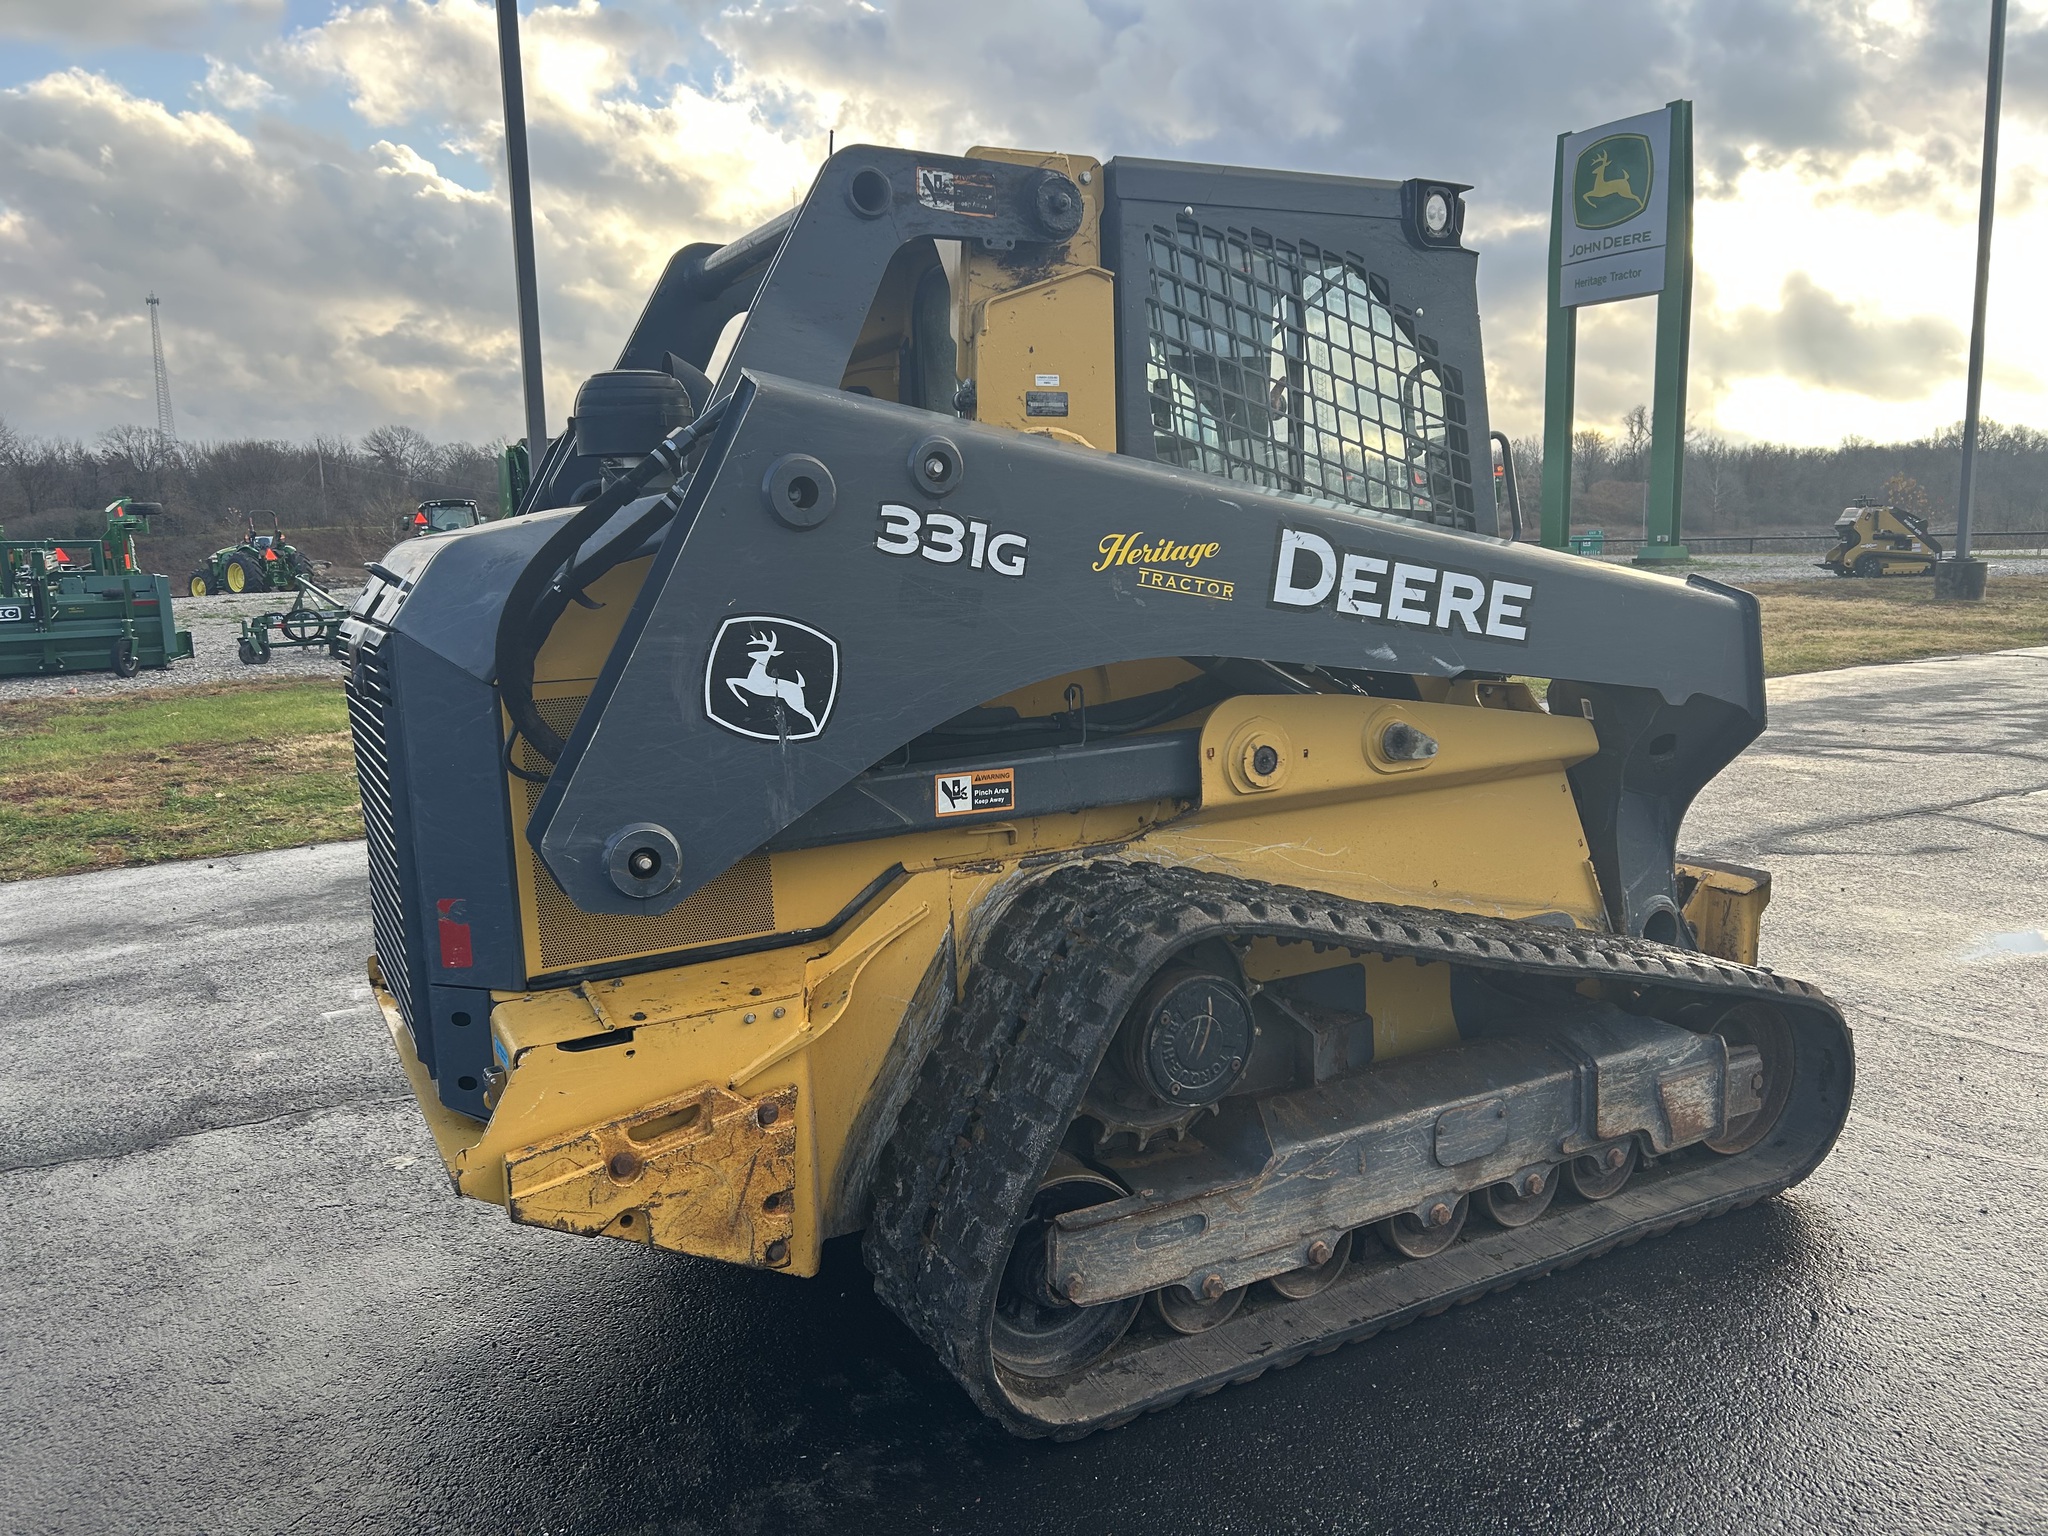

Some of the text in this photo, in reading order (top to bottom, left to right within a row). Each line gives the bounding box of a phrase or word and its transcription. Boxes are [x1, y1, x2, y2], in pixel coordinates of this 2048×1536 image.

[1569, 231, 1652, 258] JOHN DEERE
[1574, 268, 1642, 289] Heritage Tractor
[876, 504, 1027, 577] 331G
[1092, 531, 1221, 572] Heritage
[1138, 569, 1235, 598] TRACTOR
[1273, 528, 1533, 640] DEERE
[981, 772, 1010, 780] WARNING
[974, 787, 1009, 796] Pinch Area
